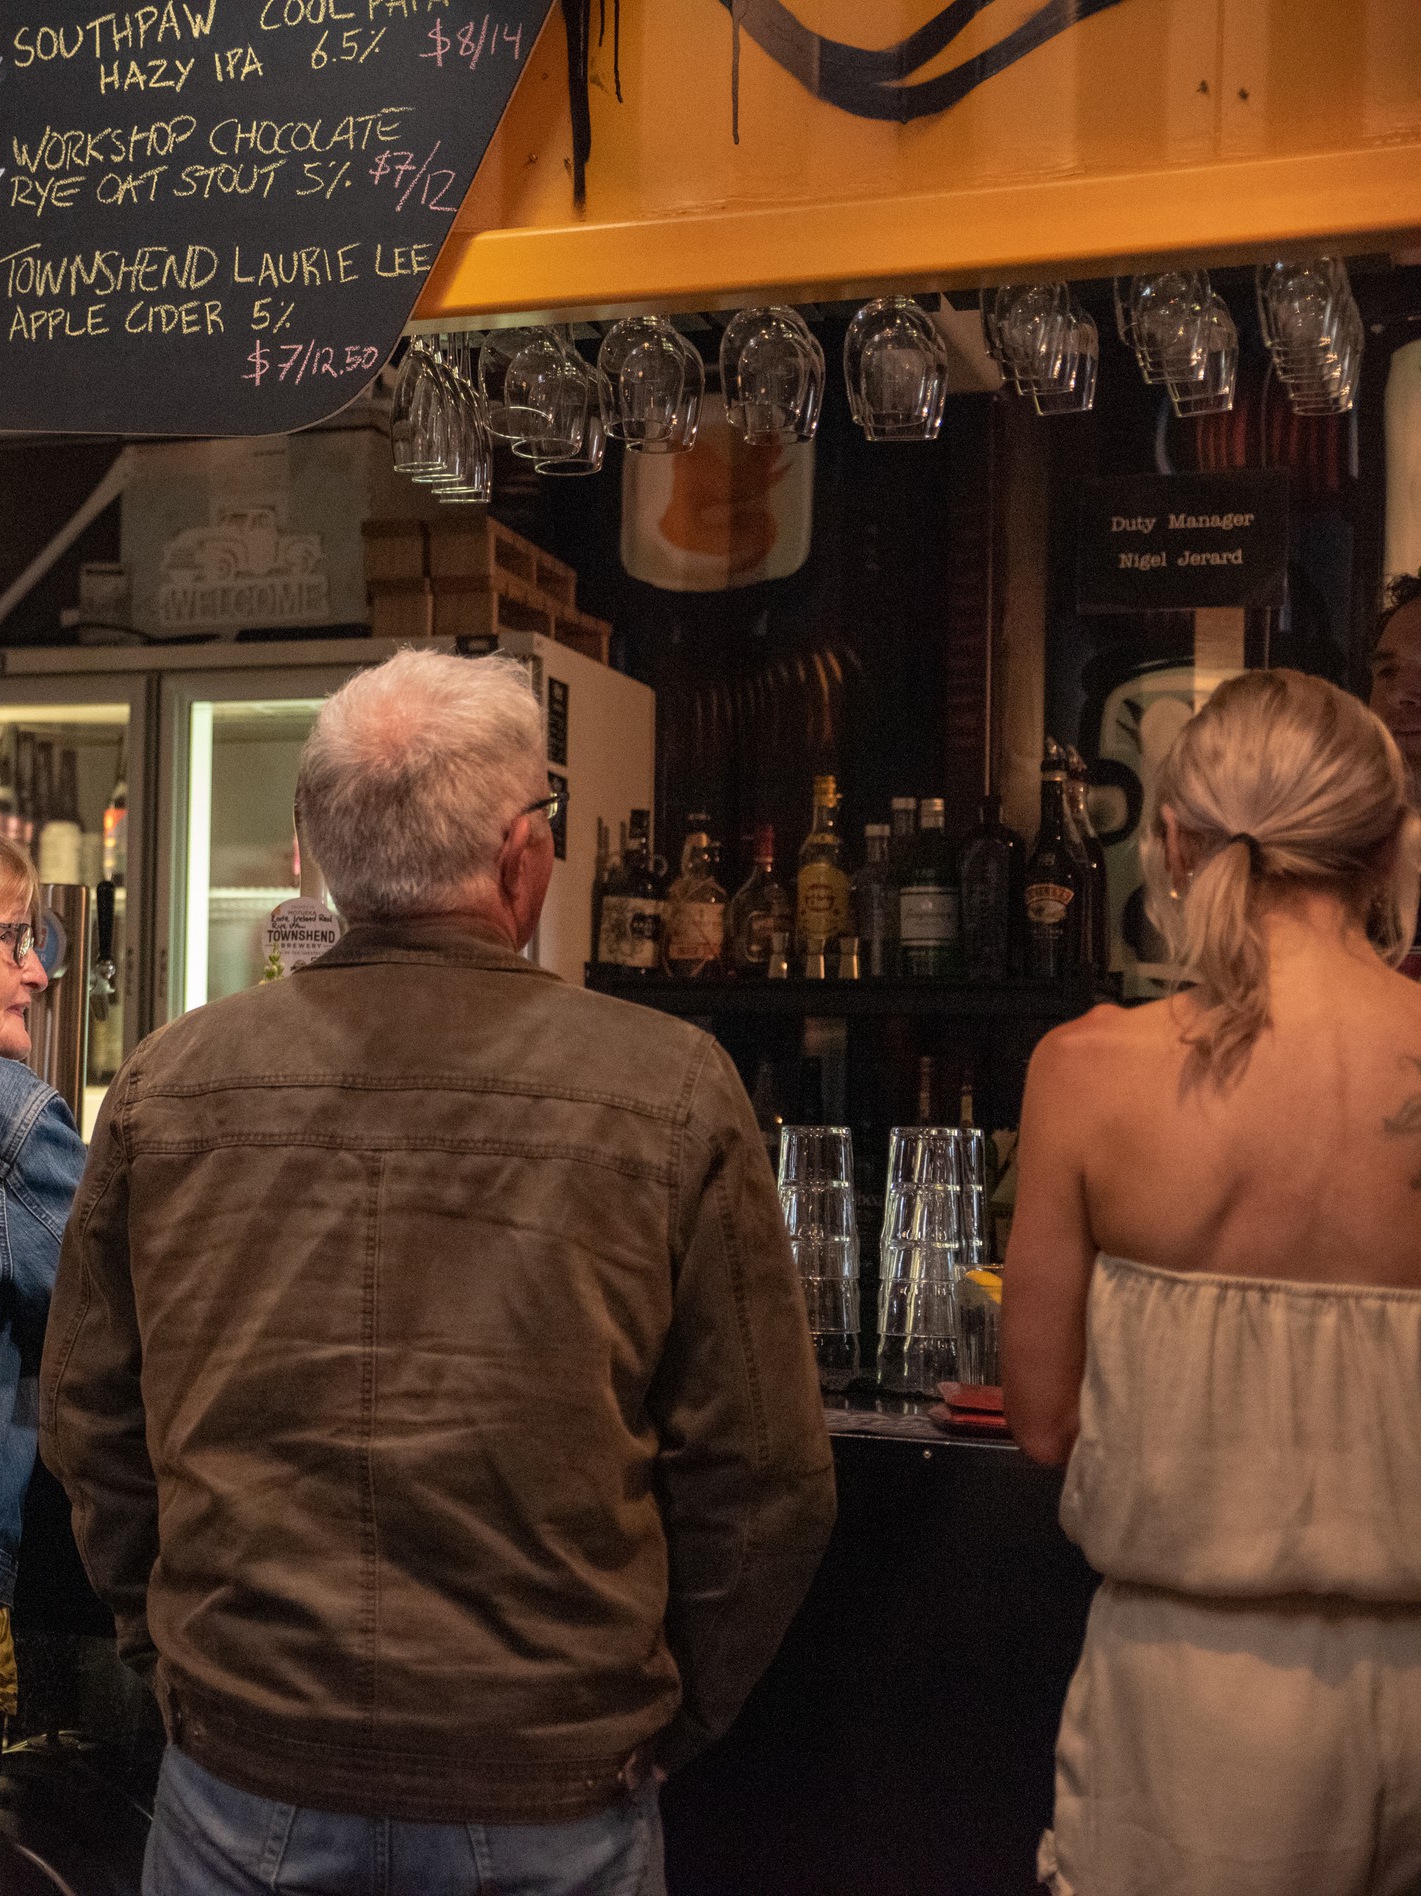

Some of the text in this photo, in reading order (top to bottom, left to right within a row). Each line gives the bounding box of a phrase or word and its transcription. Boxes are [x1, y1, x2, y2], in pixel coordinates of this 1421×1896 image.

[13, 0, 218, 68] SOUTHPAW
[100, 13, 524, 94] HAZY IPA 6.5% $8/14
[12, 105, 416, 174] WORKSHOP CHOCOLATE
[11, 140, 458, 218] RYE OAT STOUT 5% $7/12
[234, 242, 362, 288] LAURIE
[375, 244, 432, 277] LEE
[9, 298, 294, 343] APPLE CIDER 5%
[241, 340, 380, 387] $7/12.50
[1111, 512, 1255, 534] Duty Manager
[1119, 549, 1244, 571] Nigel Jerard
[164, 582, 325, 621] WELCOME
[267, 930, 336, 944] TOWNSHEND
